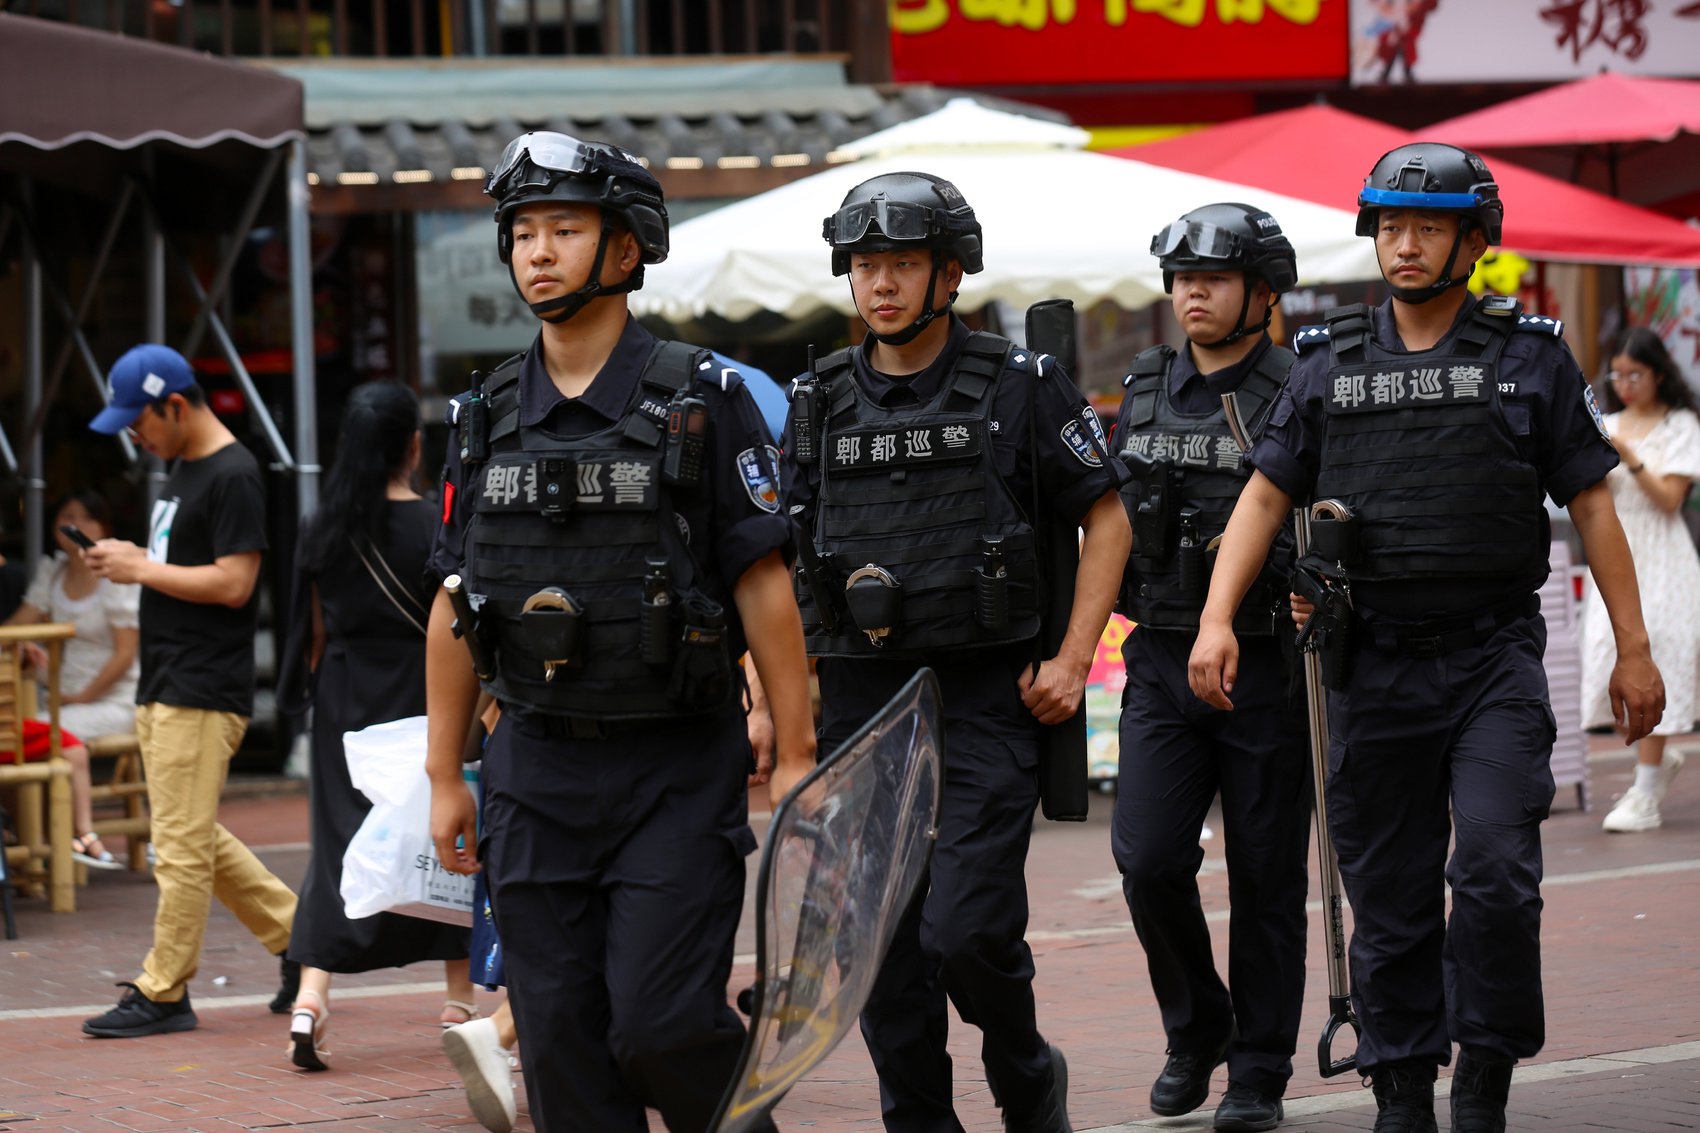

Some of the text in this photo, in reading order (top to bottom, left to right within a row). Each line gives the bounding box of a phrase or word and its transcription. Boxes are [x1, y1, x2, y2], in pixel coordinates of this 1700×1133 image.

[1332, 365, 1484, 408] 郫都巡警
[639, 399, 669, 420] JF180
[835, 425, 970, 465] 郫都巡警
